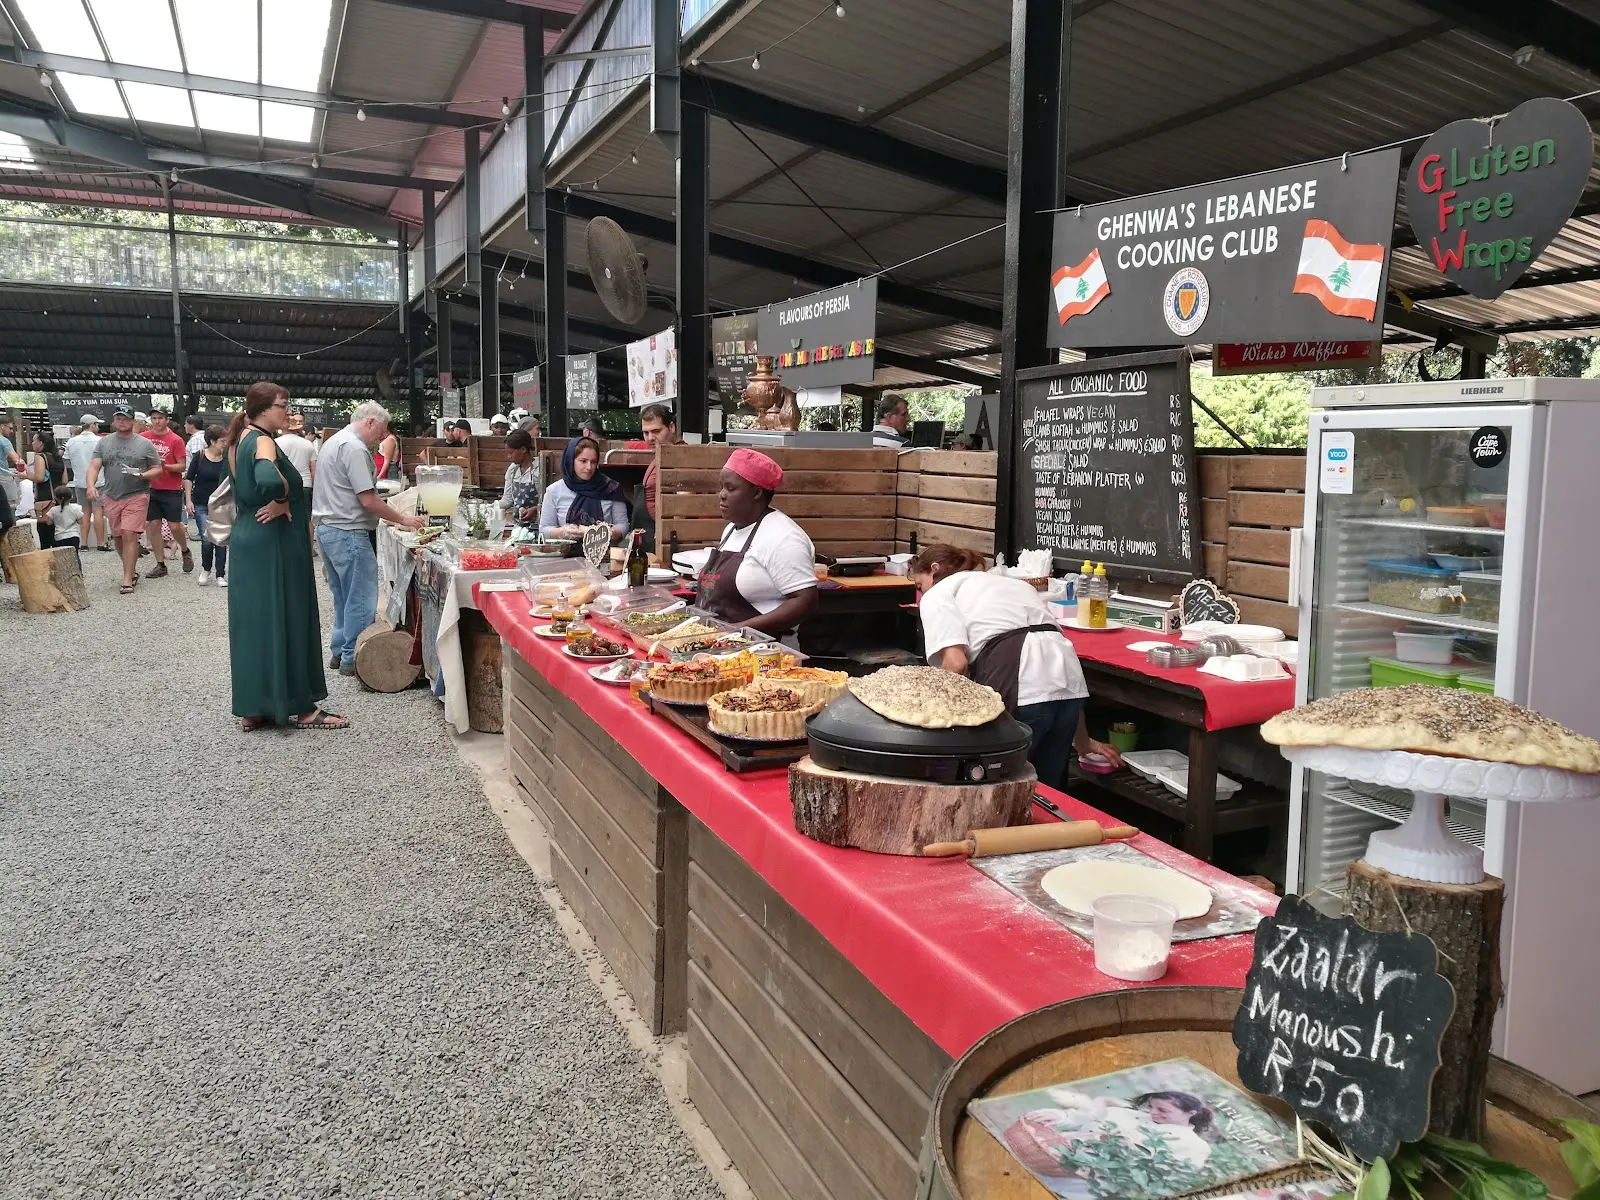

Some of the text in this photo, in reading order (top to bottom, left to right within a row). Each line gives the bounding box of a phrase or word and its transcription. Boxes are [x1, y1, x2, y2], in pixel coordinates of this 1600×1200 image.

[1097, 180, 1317, 241] GHENWA'S LEBANESE
[1438, 191, 1514, 232] Free
[1117, 225, 1278, 269] COOKING CLUB
[1431, 229, 1534, 282] Wraps
[779, 294, 850, 326] FLAVOURS OF PERSIA
[1242, 341, 1349, 362] Wicked Waffles
[1048, 370, 1147, 395] ALL ORGANIC FOOD
[1460, 386, 1504, 395] LIEBHERR
[1036, 407, 1060, 422] FALAFEL
[1062, 405, 1084, 420] WRAPS
[1086, 404, 1116, 420] VEGAN
[1035, 423, 1050, 438] LAMB
[1052, 423, 1073, 438] KOFTAH
[1081, 420, 1108, 437] HUMMUS
[1118, 418, 1139, 434] SALAD
[1115, 438, 1143, 454] HUMMUS
[1477, 436, 1498, 448] Cape
[1473, 446, 1502, 459] Town
[1034, 455, 1062, 469] SPECIAL
[1068, 453, 1088, 472] SALAD
[1035, 471, 1051, 484] TASTE
[1053, 472, 1060, 484] OF
[1062, 471, 1093, 487] LEBANON
[1095, 471, 1132, 490] PLATTER
[1035, 510, 1052, 521] VEGAN
[1054, 511, 1072, 523] SALAD
[1035, 522, 1052, 534] VEGAN
[1080, 525, 1104, 538] HUMMUS
[1126, 539, 1157, 556] HUMMUS
